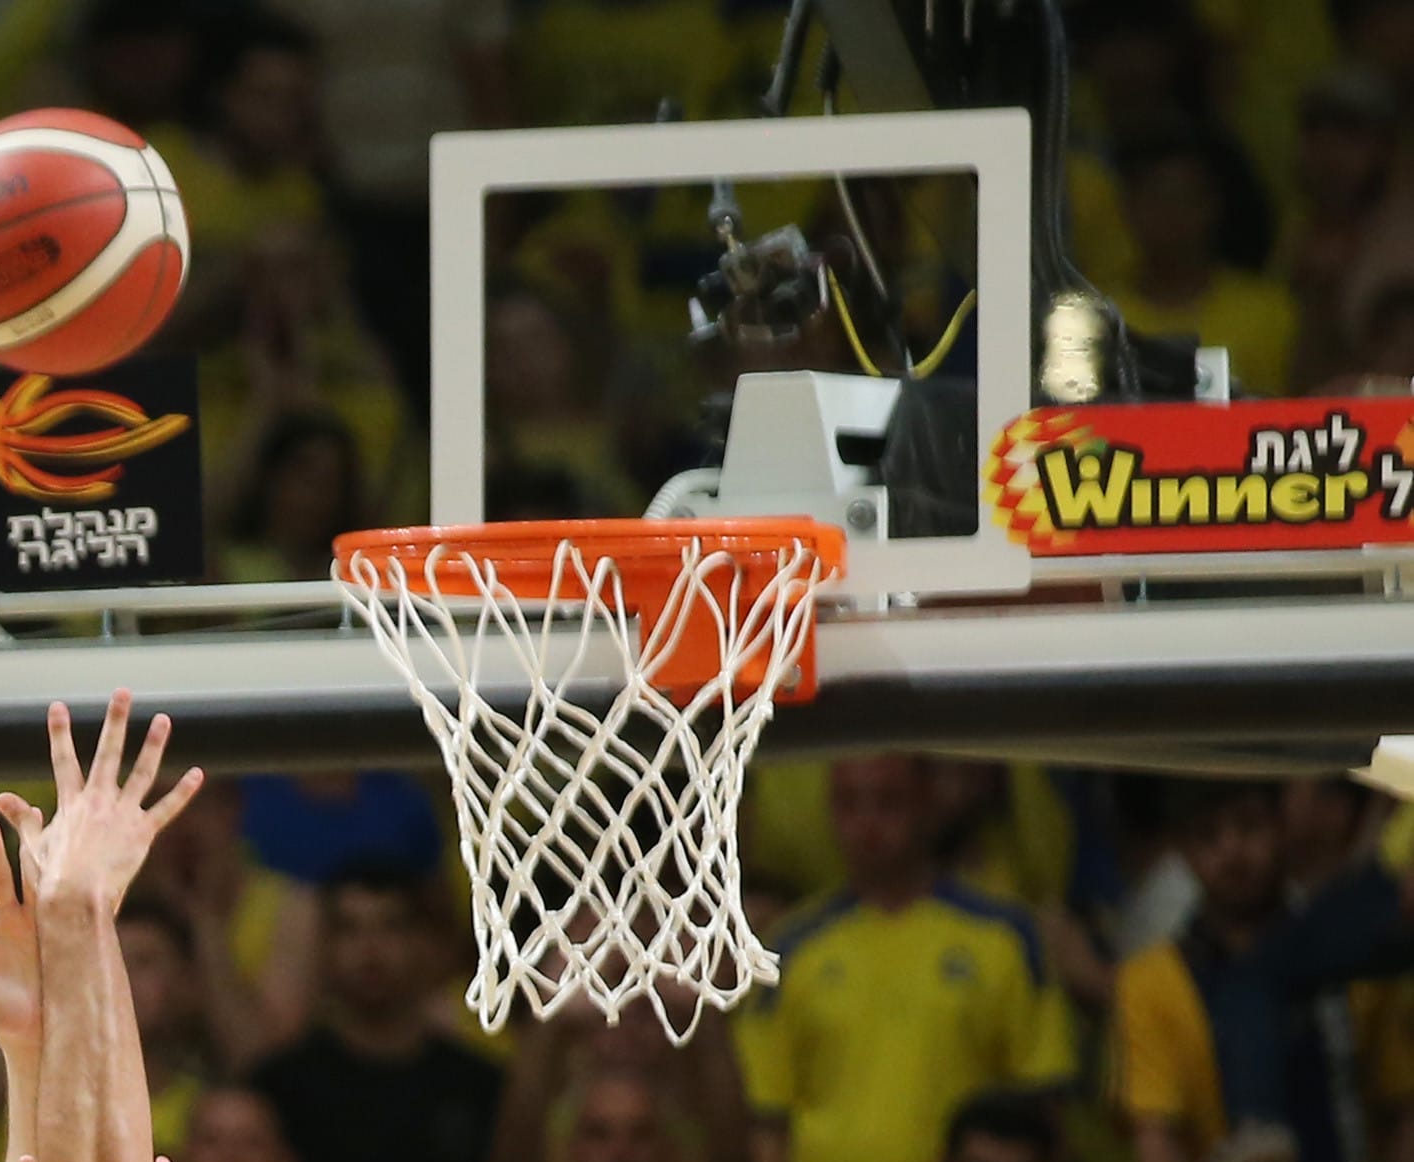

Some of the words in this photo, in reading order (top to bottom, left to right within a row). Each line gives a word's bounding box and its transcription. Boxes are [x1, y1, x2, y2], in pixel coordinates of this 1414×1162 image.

[1251, 414, 1359, 473] ליגת
[1042, 448, 1368, 527] Winner
[7, 507, 158, 548] מנהלת
[18, 531, 149, 573] הליגה
